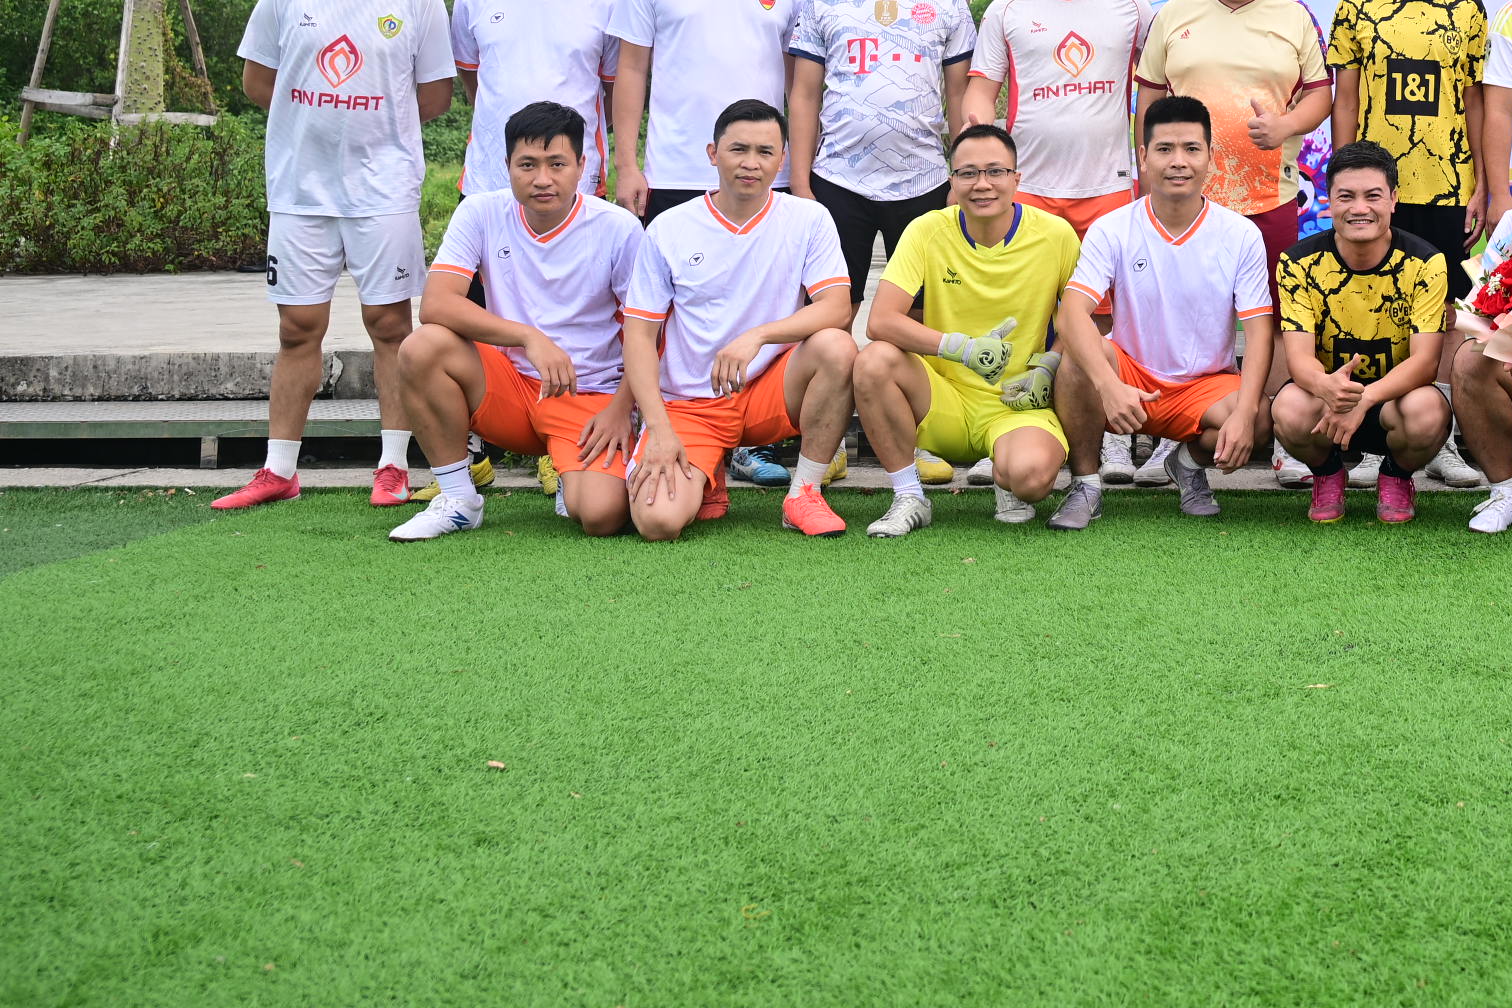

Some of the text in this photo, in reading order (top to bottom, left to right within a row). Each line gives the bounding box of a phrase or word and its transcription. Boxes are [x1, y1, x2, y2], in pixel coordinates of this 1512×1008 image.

[1033, 80, 1116, 101] AN PHAT
[1391, 72, 1436, 103] 1&1
[291, 88, 385, 111] AN PHAT
[1392, 302, 1410, 318] BVB
